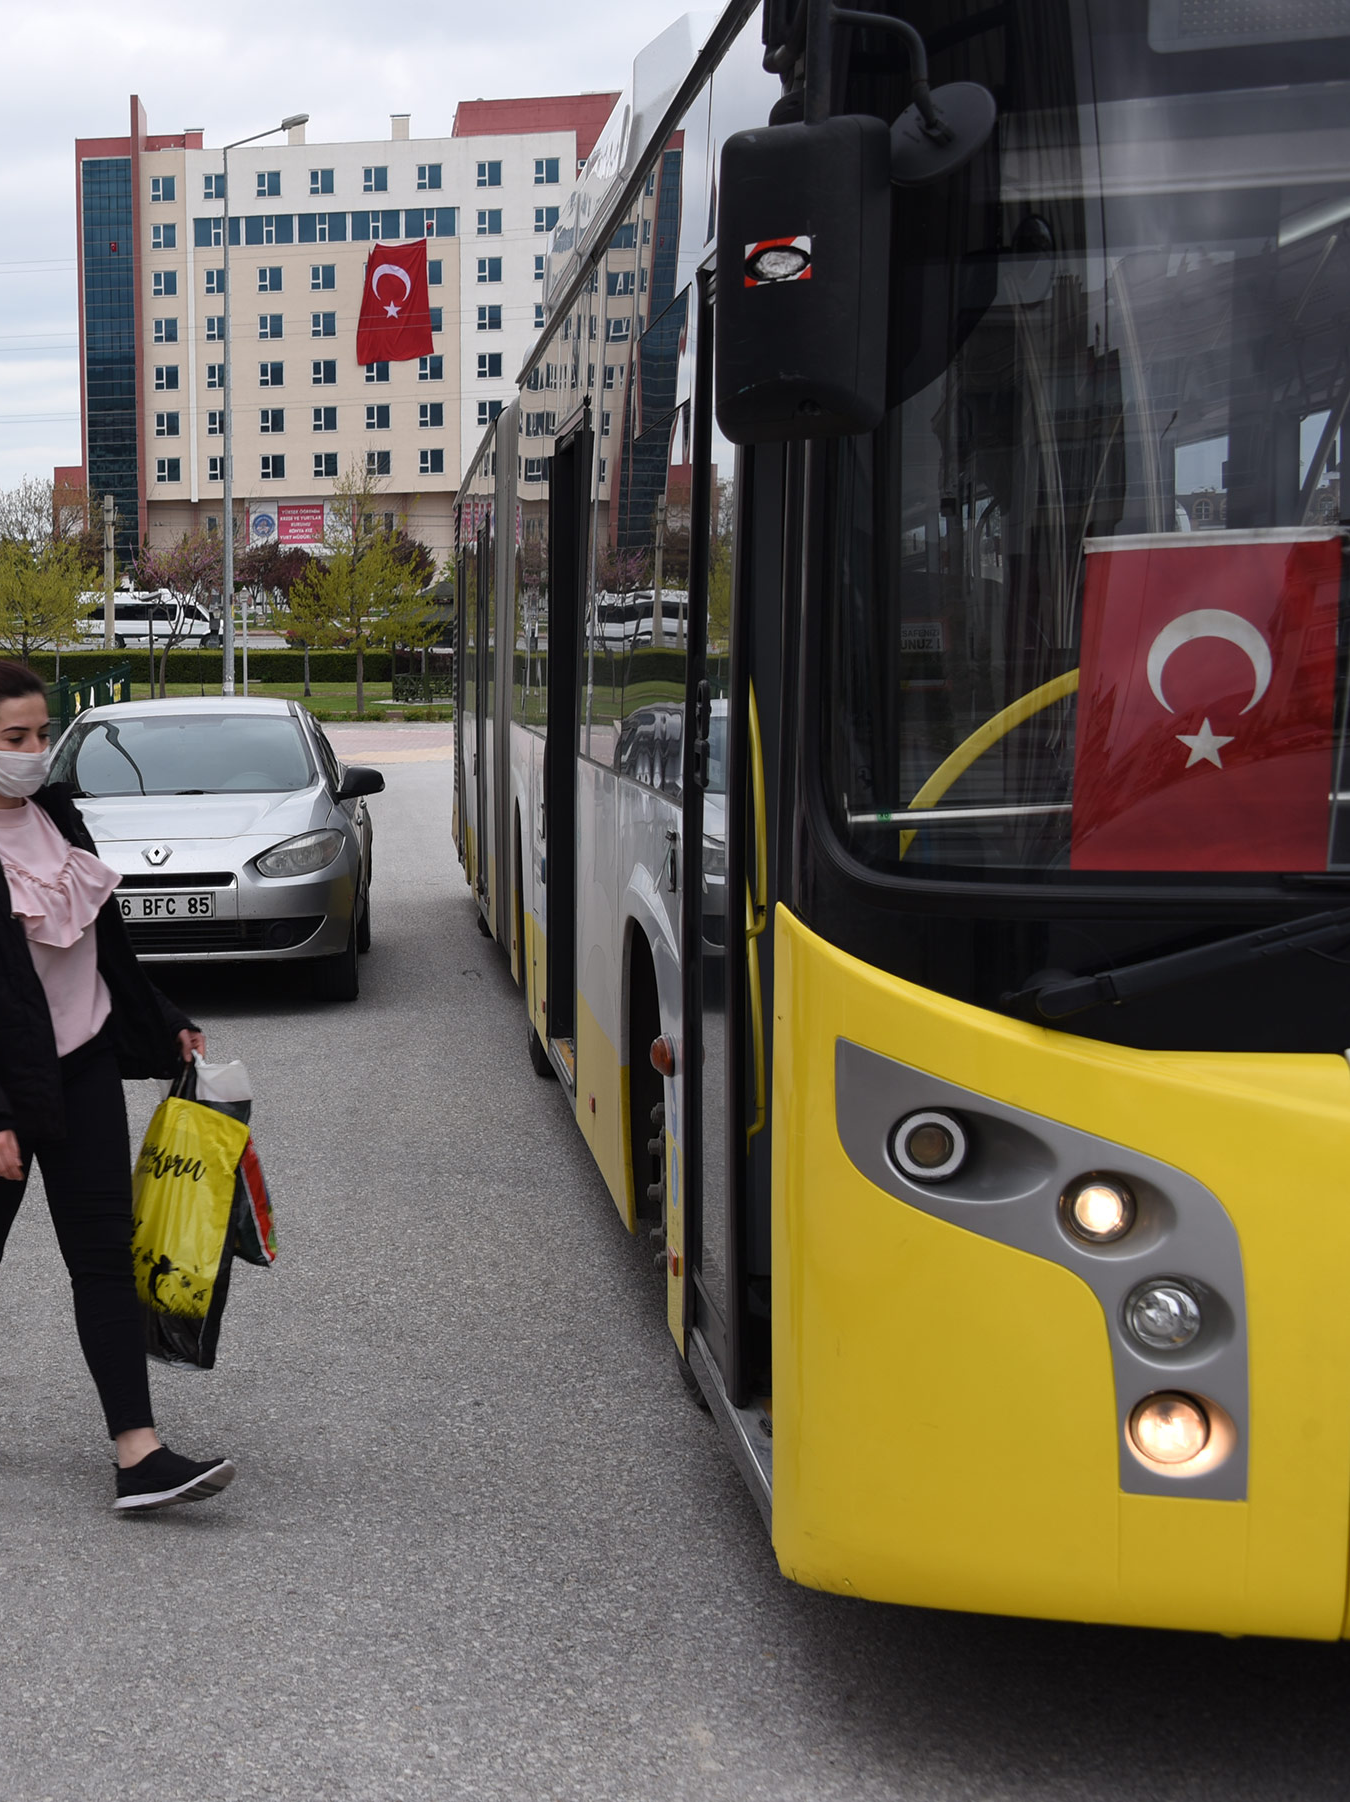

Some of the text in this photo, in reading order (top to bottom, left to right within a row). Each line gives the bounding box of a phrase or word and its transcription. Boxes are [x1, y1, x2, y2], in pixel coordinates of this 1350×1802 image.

[121, 897, 209, 916] 6 BFC 85
